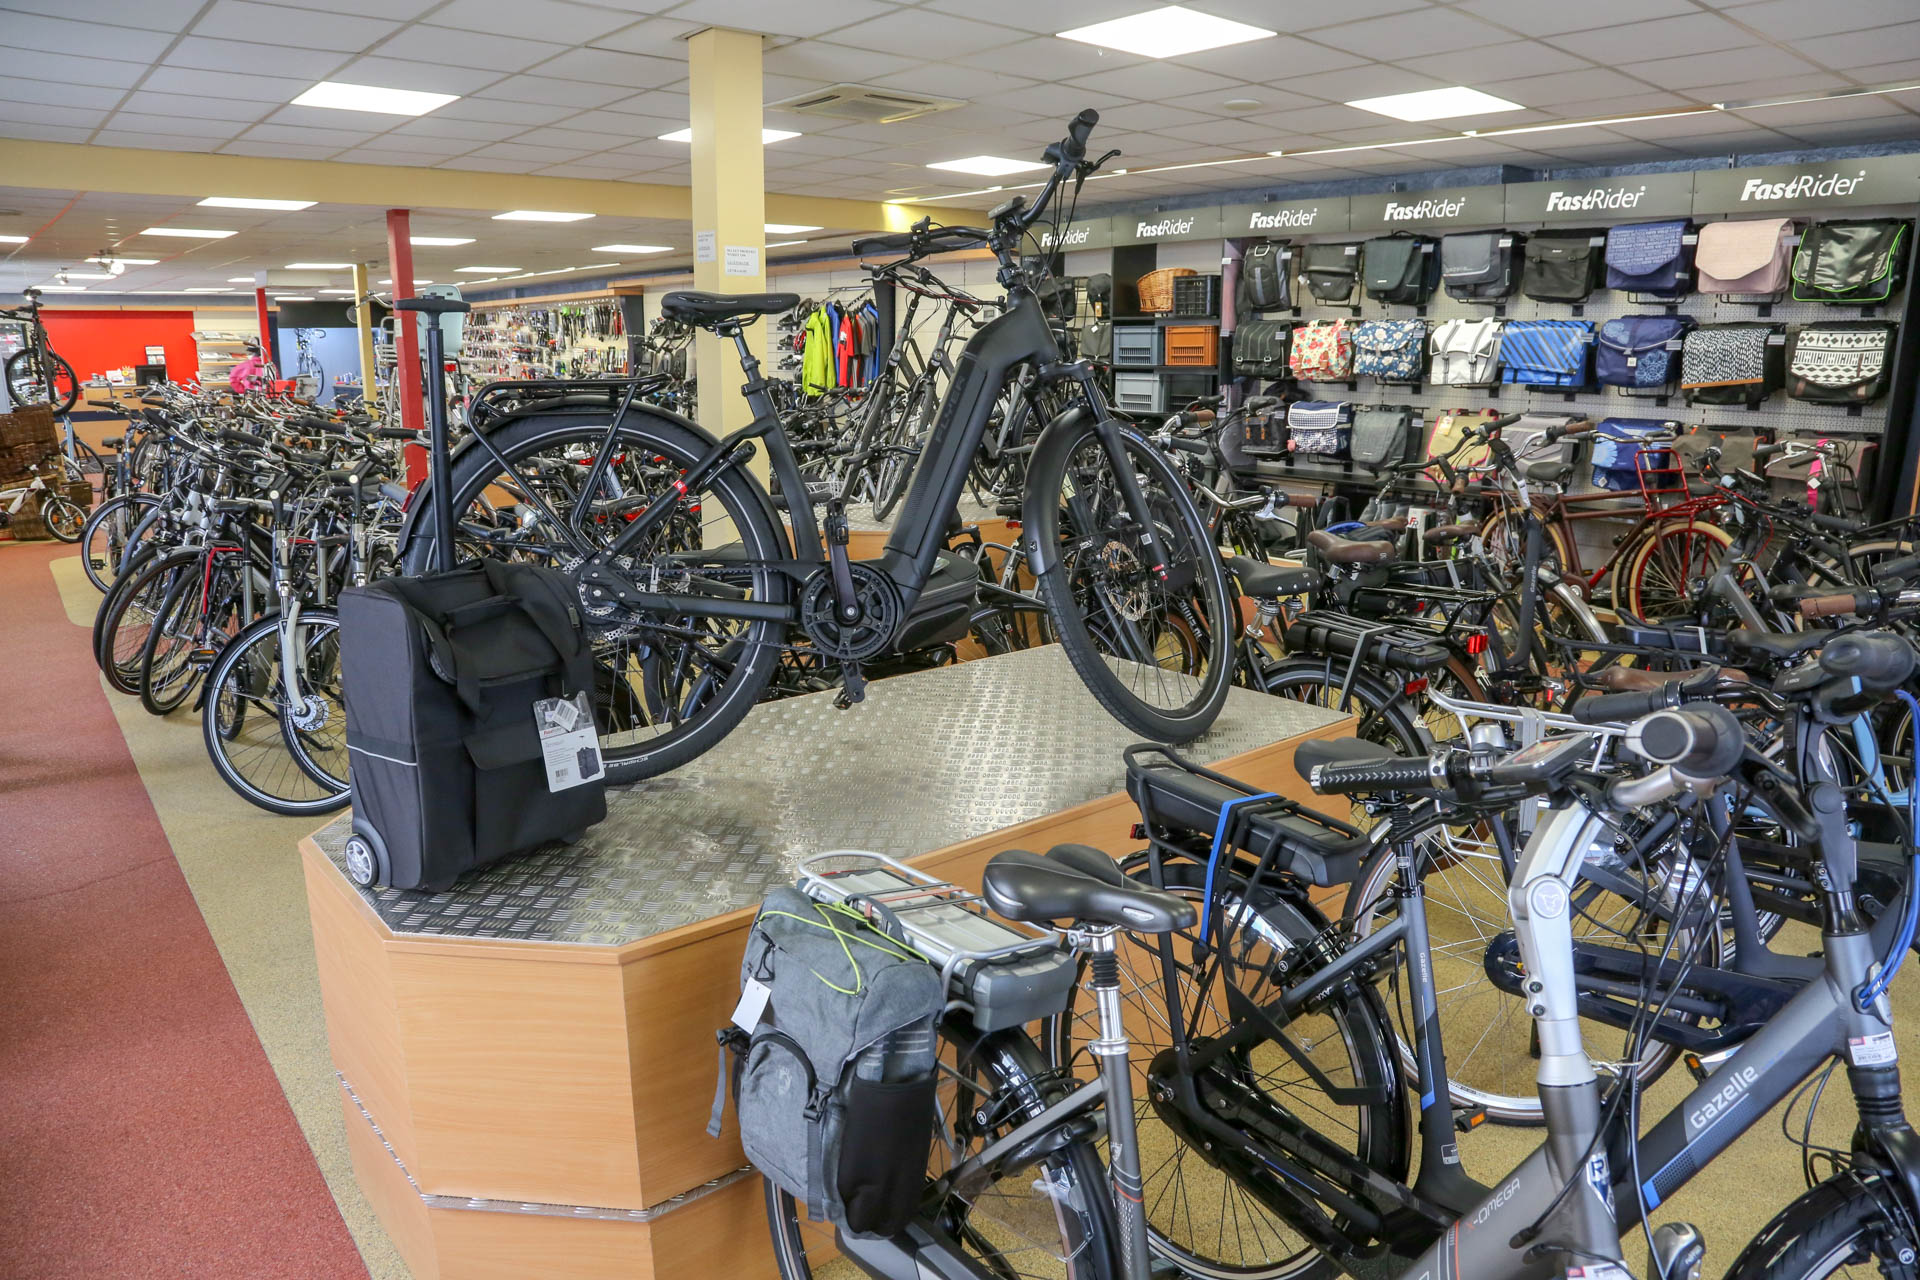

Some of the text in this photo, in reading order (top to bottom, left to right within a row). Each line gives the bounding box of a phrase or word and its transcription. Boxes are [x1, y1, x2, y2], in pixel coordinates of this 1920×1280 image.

[1546, 185, 1646, 212] FastRider
[1740, 170, 1866, 201] FastRider
[1249, 207, 1318, 229] FastRider
[1383, 196, 1466, 221] FastRider
[1136, 216, 1194, 238] FastRider
[1419, 952, 1428, 983] Gazelle
[1690, 1066, 1759, 1129] Gazelle
[1464, 1177, 1521, 1230] X-OMEGA
